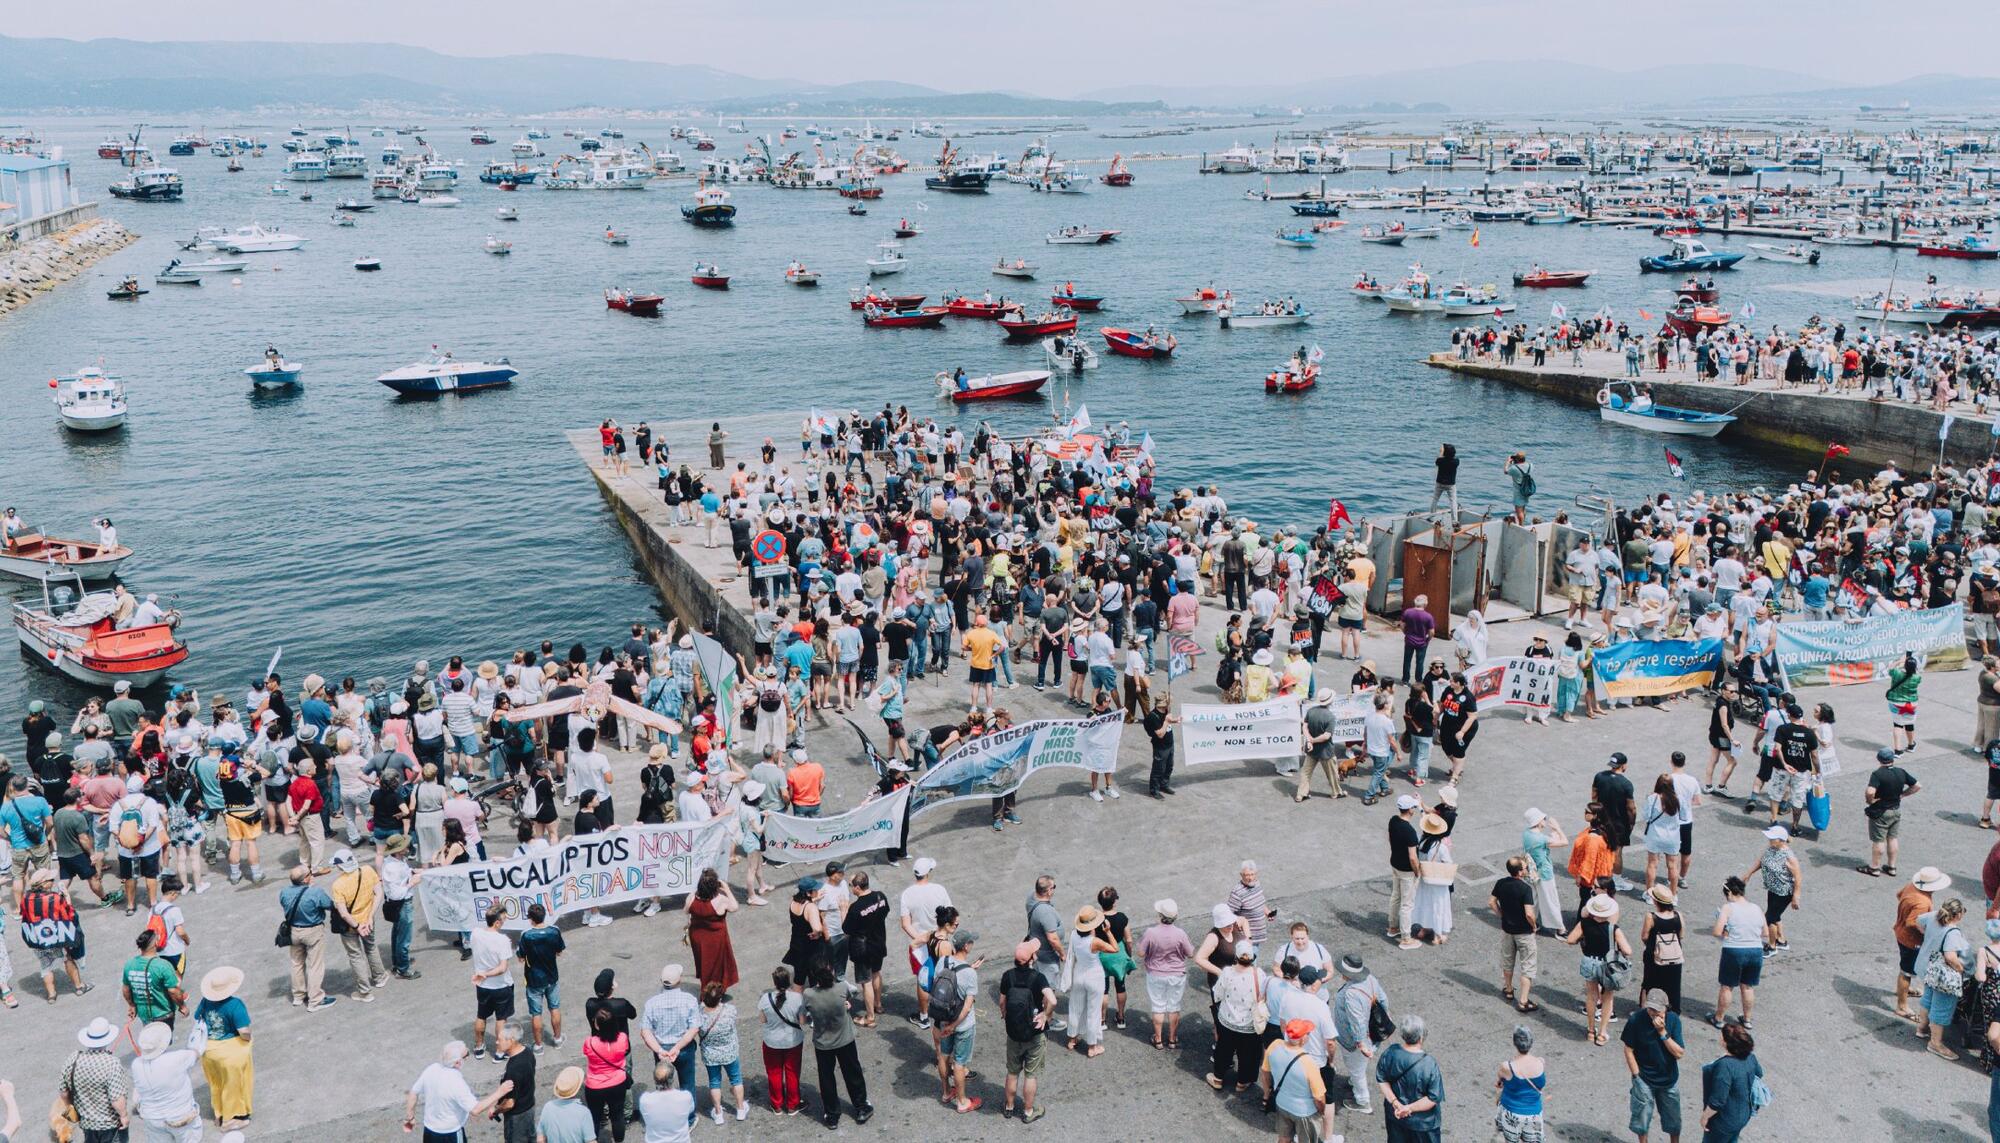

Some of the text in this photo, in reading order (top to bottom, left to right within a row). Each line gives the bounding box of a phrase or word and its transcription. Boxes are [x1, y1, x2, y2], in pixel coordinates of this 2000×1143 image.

[1813, 636, 1839, 648] POLO
[1800, 650, 1832, 663] UNHA
[1871, 643, 1894, 657] VIVA
[1511, 688, 1550, 705] NON
[1235, 711, 1256, 719] NON
[1259, 708, 1271, 718] SE
[1050, 726, 1078, 737] NON
[1215, 724, 1254, 732] VENDE
[982, 737, 991, 751] O
[1043, 736, 1076, 751] MAIS
[1224, 738, 1246, 746] NON
[1250, 737, 1262, 745] SE
[1267, 735, 1294, 745] TOCA
[468, 829, 693, 893] EUCALIPTOS NON
[668, 855, 693, 888] SI
[21, 918, 76, 947] NON
